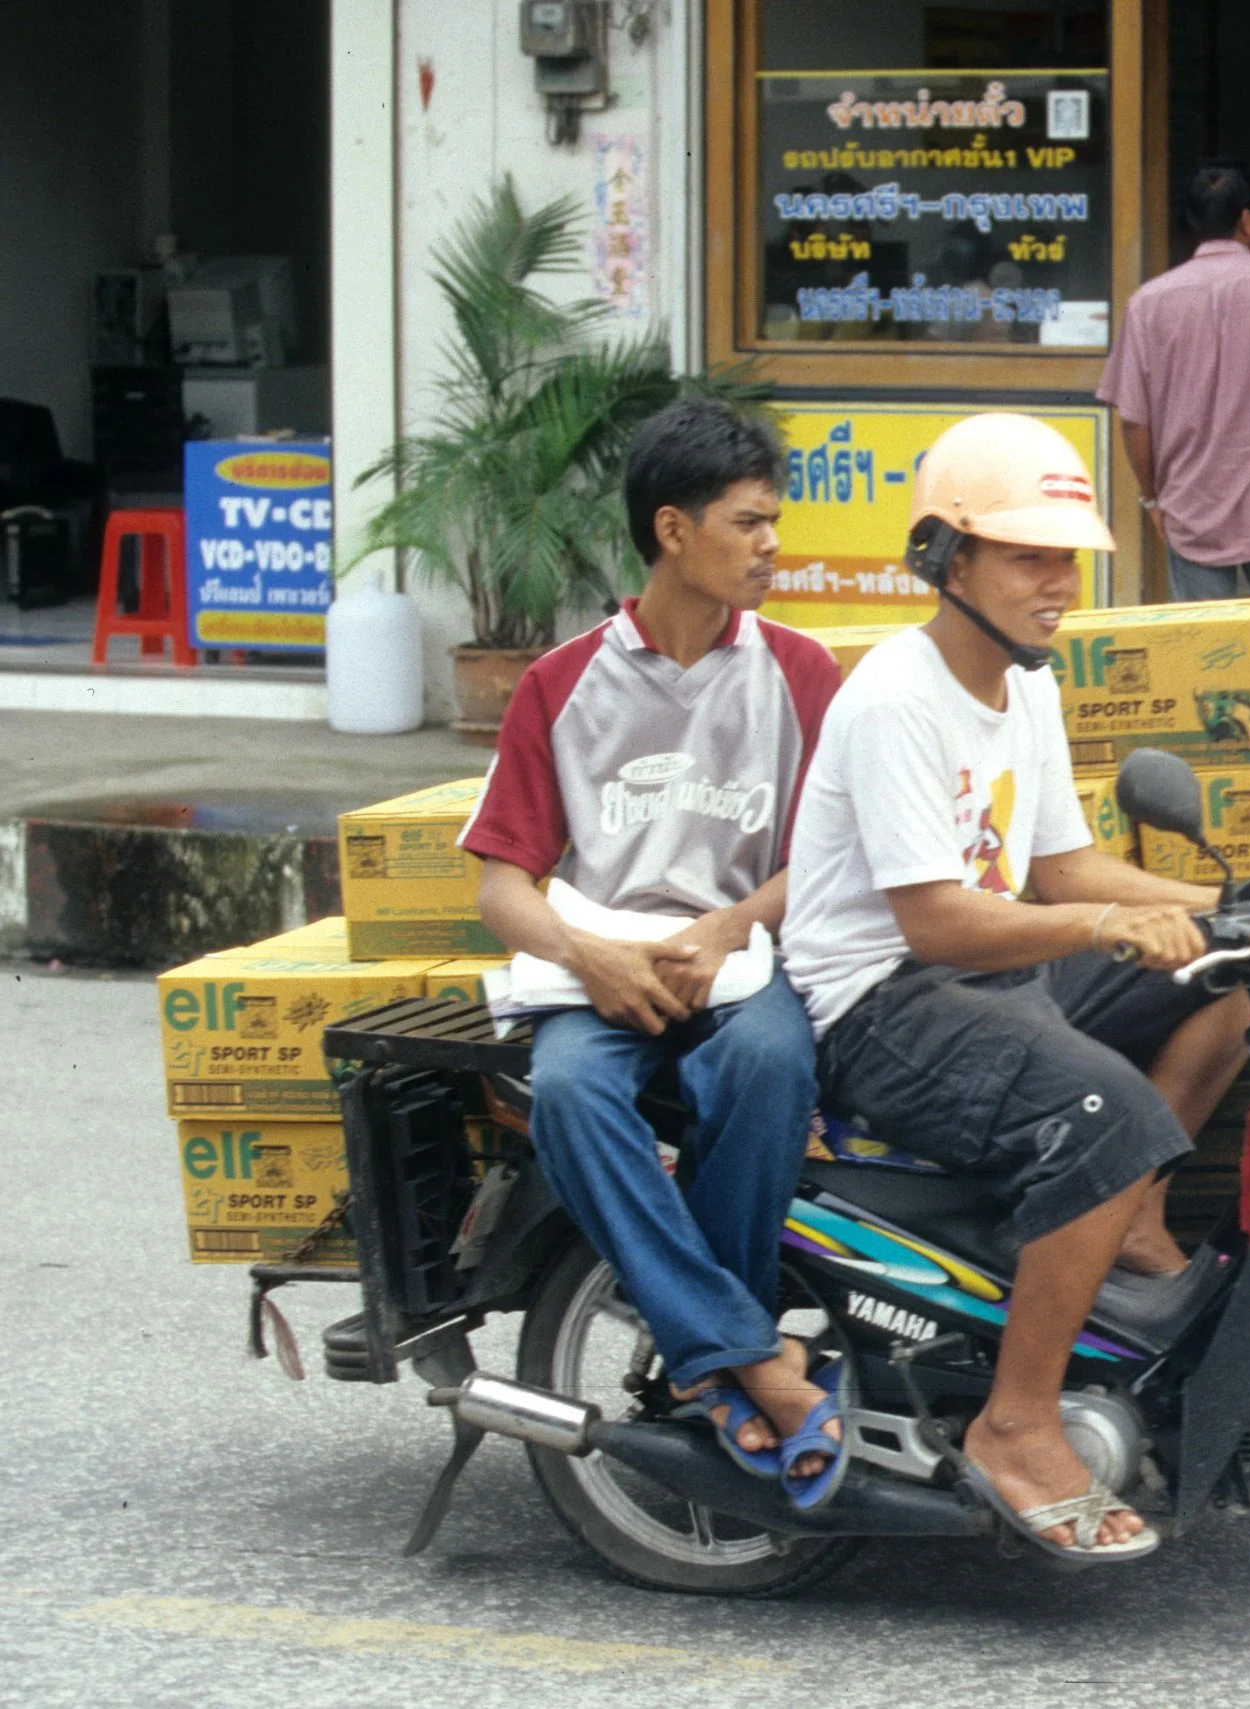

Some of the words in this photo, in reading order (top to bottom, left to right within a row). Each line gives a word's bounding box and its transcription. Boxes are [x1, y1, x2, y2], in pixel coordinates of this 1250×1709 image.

[827, 81, 1026, 128] จำหน่ายตั๋ว
[1026, 147, 1076, 169] VIP
[1078, 700, 1143, 719] SPORT
[1152, 698, 1177, 714] SP
[165, 982, 245, 1032] elf
[210, 1046, 271, 1061] SPORT
[278, 1046, 302, 1062] SP
[185, 1130, 262, 1180] elf
[227, 1193, 287, 1209] SPORT
[294, 1194, 317, 1209] SP
[847, 1289, 939, 1342] YAMAHA
